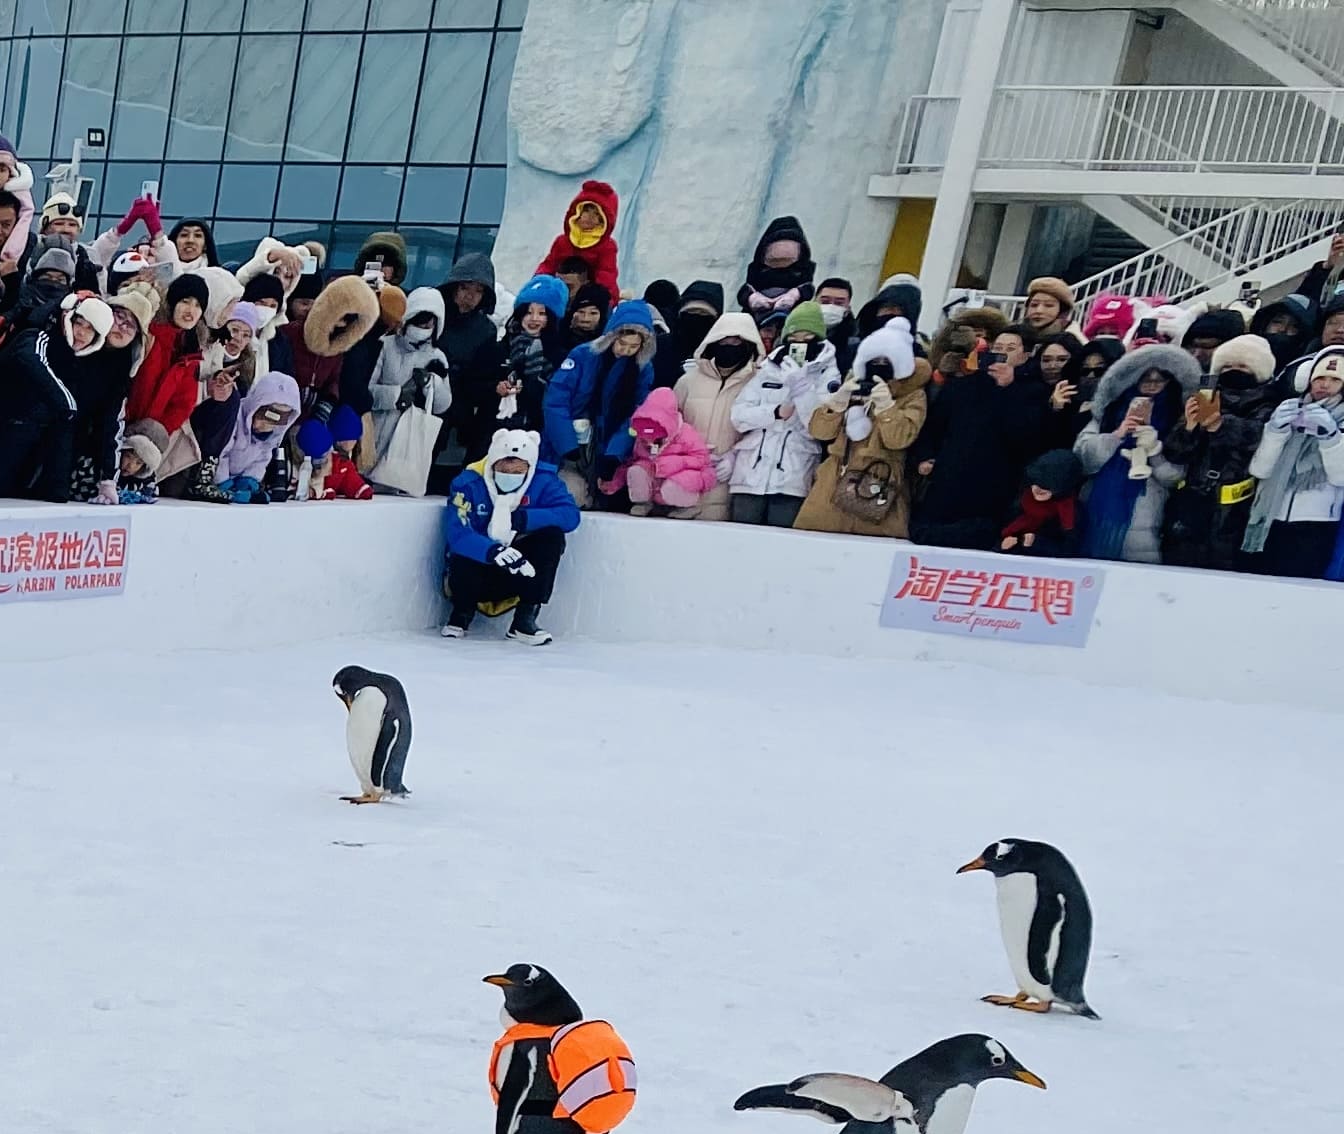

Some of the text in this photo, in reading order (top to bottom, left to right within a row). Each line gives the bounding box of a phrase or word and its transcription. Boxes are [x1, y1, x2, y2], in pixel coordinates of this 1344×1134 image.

[64, 572, 122, 590] POLARPARK
[894, 556, 1075, 625] 淘学企鹅
